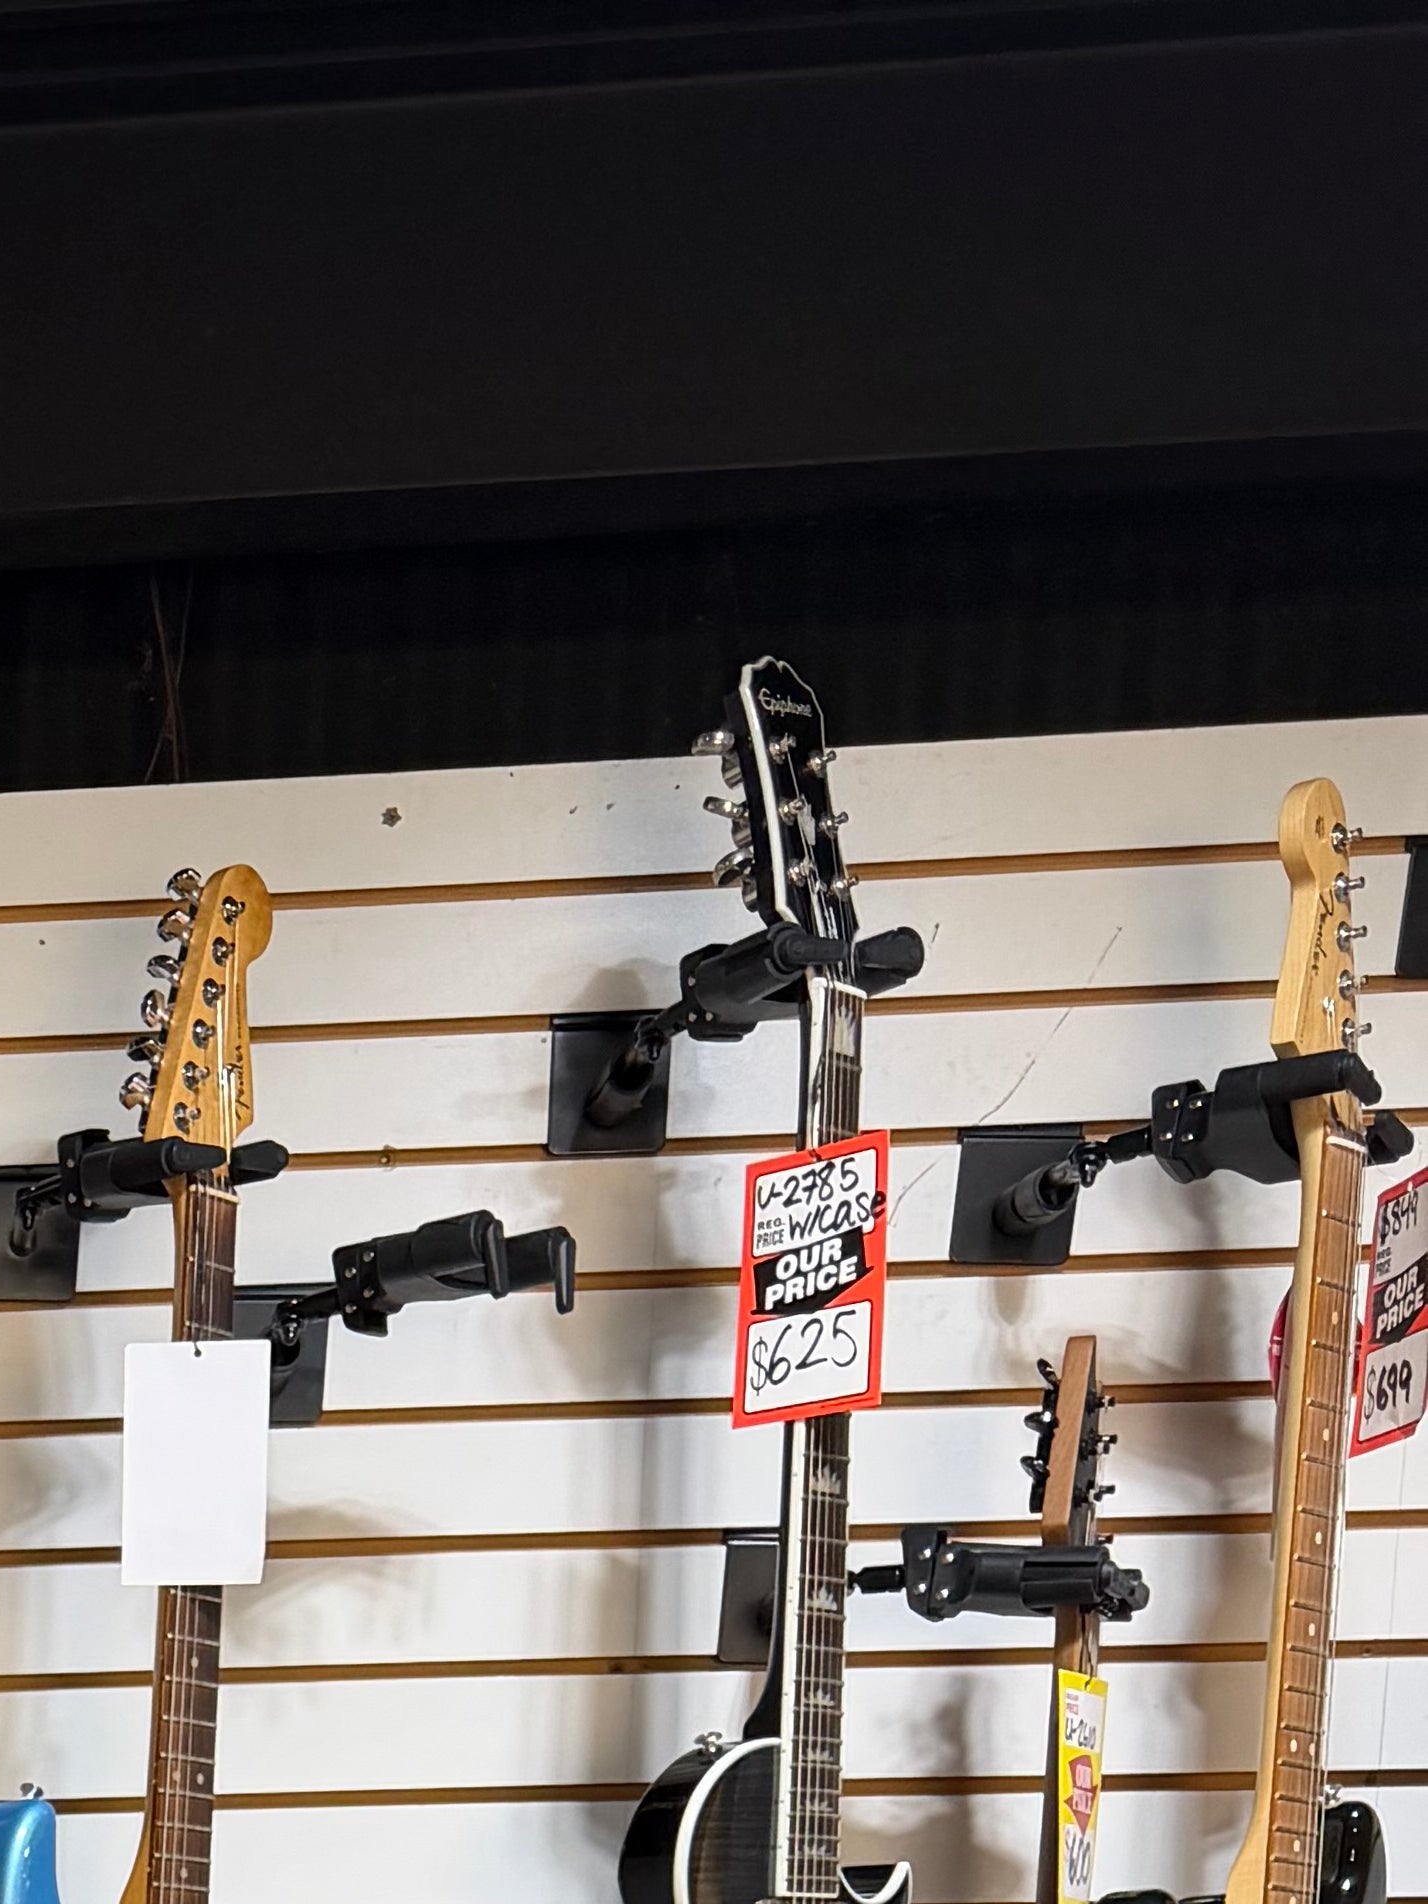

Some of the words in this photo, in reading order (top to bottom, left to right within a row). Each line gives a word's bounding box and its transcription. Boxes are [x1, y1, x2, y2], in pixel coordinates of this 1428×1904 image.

[758, 687, 813, 718] Epiphone
[1311, 887, 1335, 977] Fender
[757, 1157, 859, 1210] U-2785
[756, 1228, 785, 1250] PRICE
[775, 1237, 843, 1280] OUR
[764, 1256, 859, 1311] PRICE
[1383, 1265, 1419, 1310] OUR
[1375, 1284, 1425, 1340] PRICE
[750, 1309, 858, 1397] $625
[1363, 1358, 1413, 1424] $699
